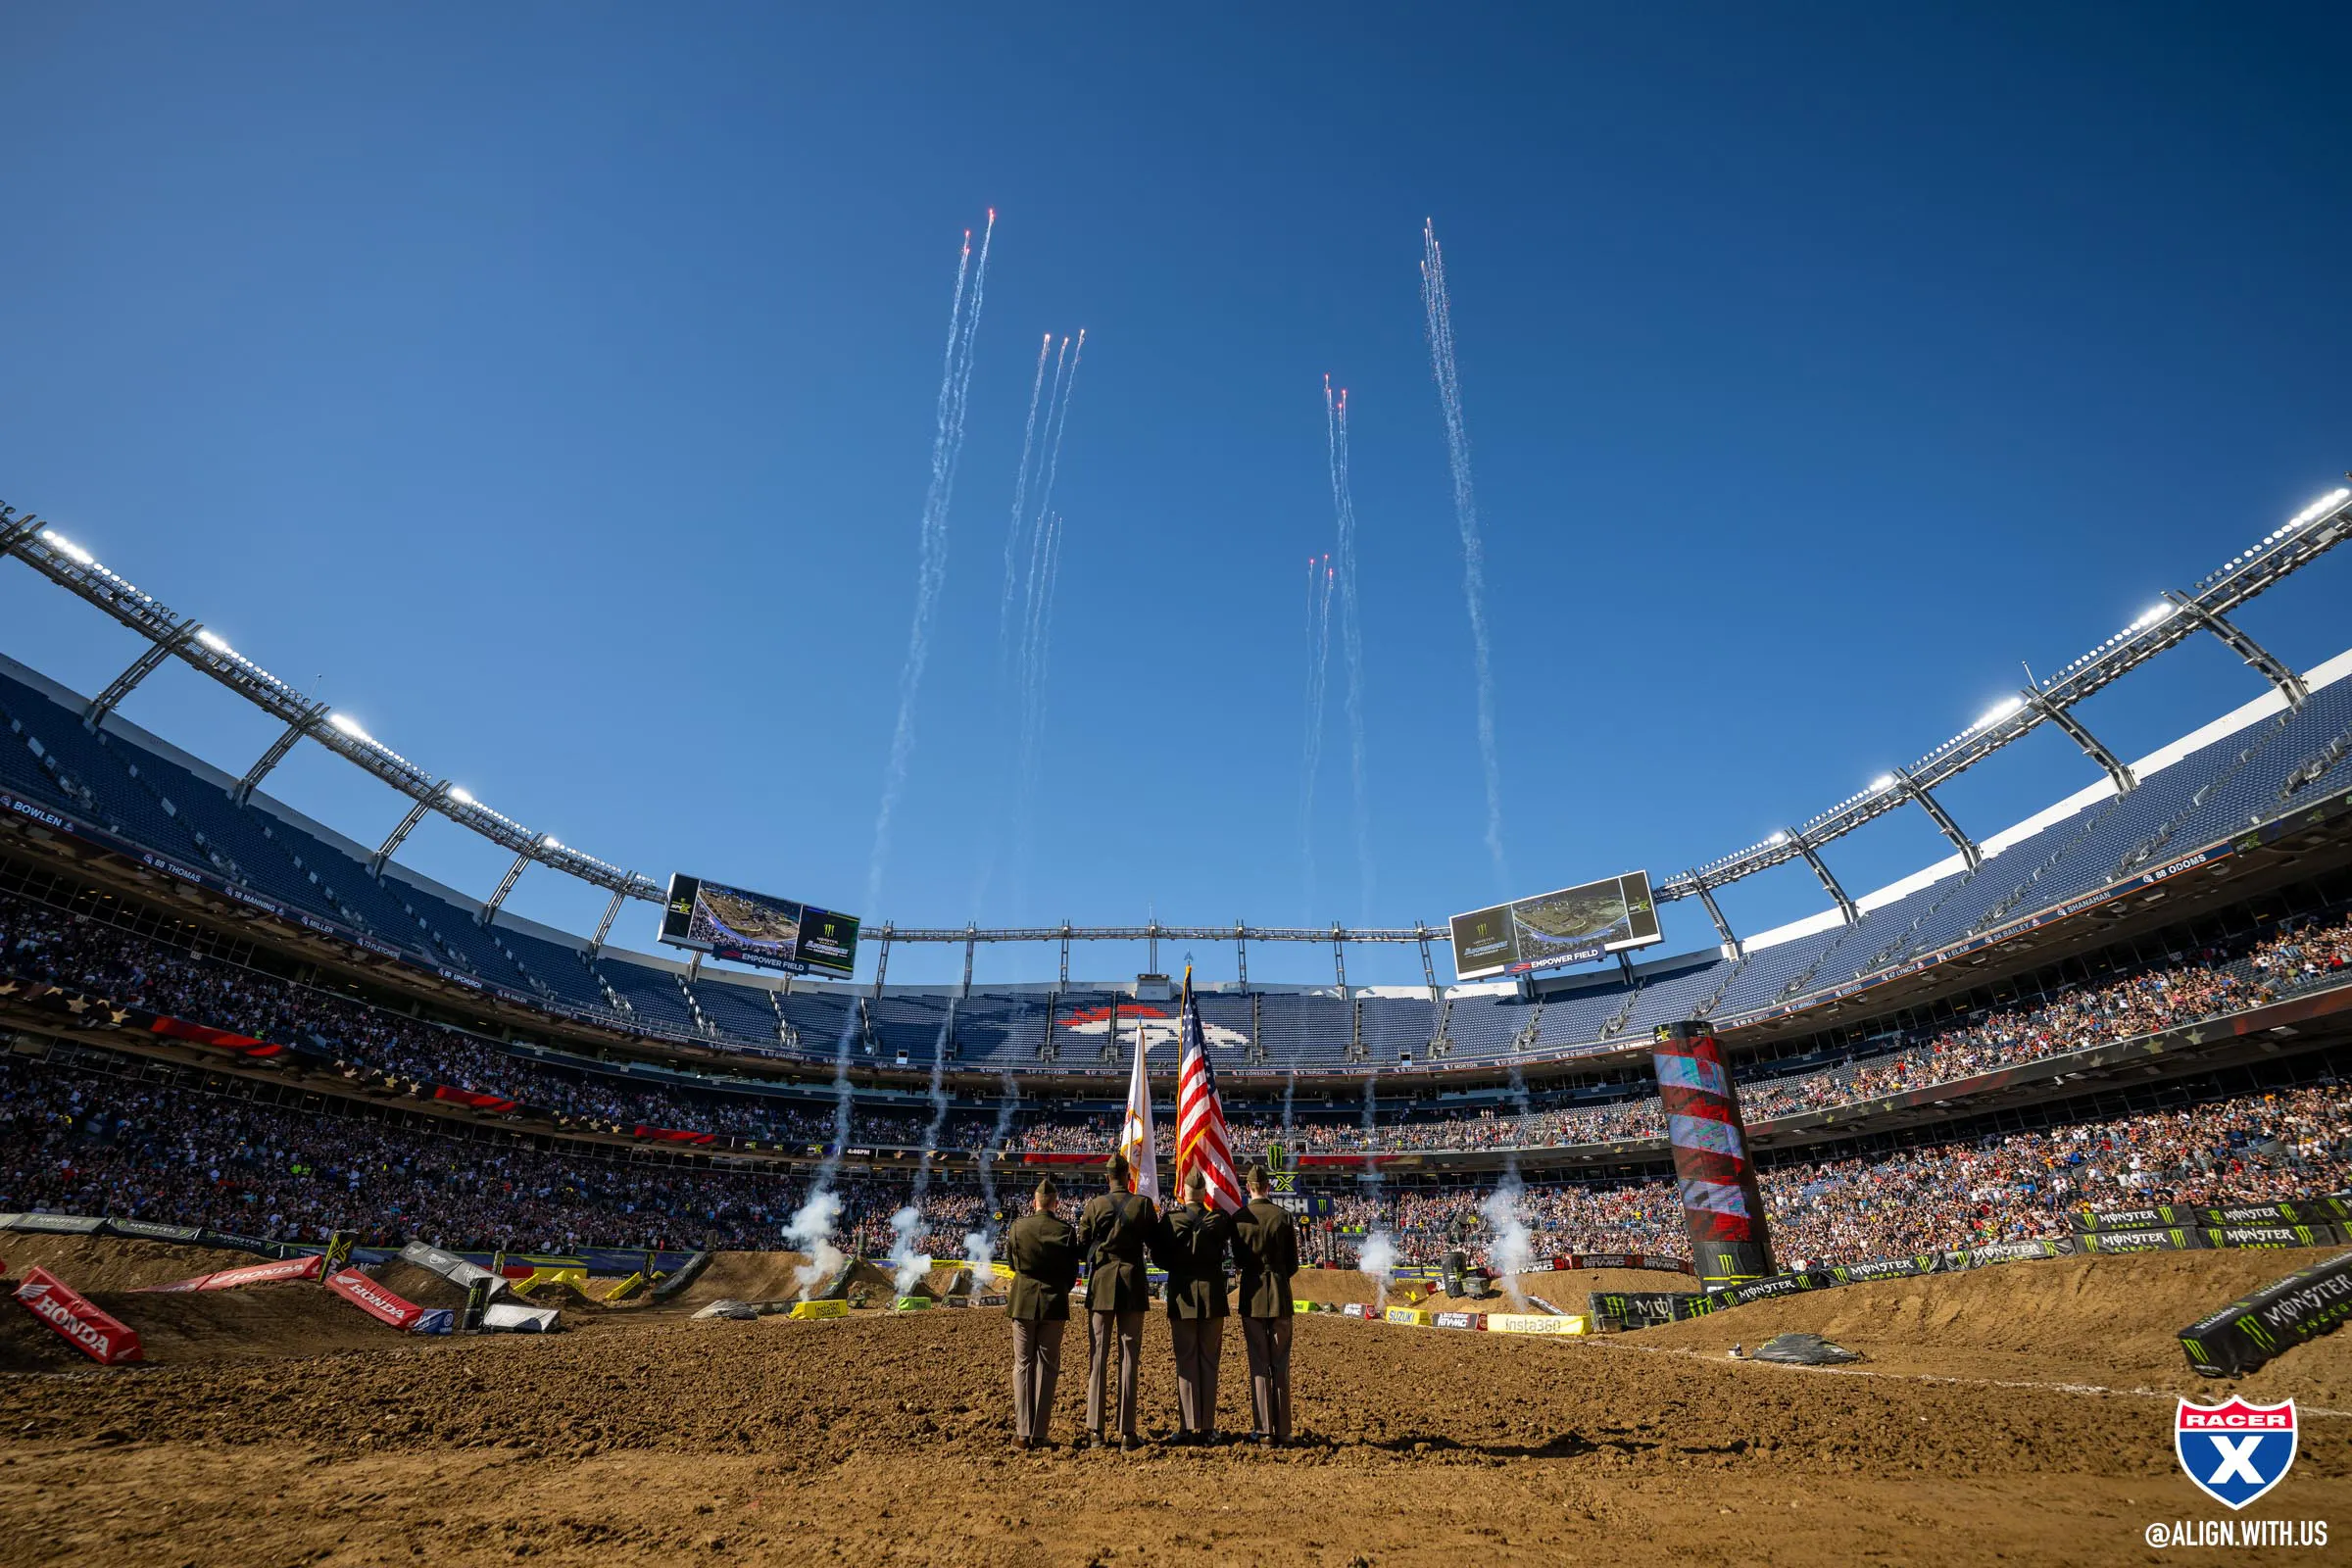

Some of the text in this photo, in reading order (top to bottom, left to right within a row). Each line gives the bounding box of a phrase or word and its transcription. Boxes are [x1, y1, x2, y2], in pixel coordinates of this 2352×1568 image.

[13, 801, 63, 827] BOWLEN
[169, 863, 202, 883] THOMAS
[2155, 854, 2207, 879] 88 ODOMS
[234, 890, 275, 912] 18 MANNING
[2067, 891, 2111, 913] SHANAHAN
[309, 919, 334, 934] MILLER
[2002, 922, 2030, 938] BAILEY
[370, 943, 400, 960] FLETCHER
[1951, 944, 1971, 956] ELAM
[742, 953, 805, 971] EMPOWER FIELD
[1531, 949, 1598, 968] EMPOWER FIELD
[1896, 964, 1916, 977] LYNCH
[453, 974, 482, 989] UPCHURCH
[1841, 983, 1862, 996] REEVES
[1798, 999, 1817, 1009] MINGO
[2099, 1209, 2157, 1223] MONSTER
[2224, 1206, 2279, 1221] MONSTER
[2101, 1232, 2168, 1247] MONSTER
[2226, 1227, 2295, 1243] MONSTER
[1971, 1243, 2040, 1258] MONSTER
[228, 1263, 305, 1282] HONDA
[1850, 1259, 1913, 1275] MONSTER
[1738, 1279, 1795, 1298] MONSTER
[348, 1284, 406, 1319] HONDA
[2262, 1273, 2352, 1327] MONSTER
[1388, 1310, 1415, 1323] SUZUKI
[35, 1294, 109, 1357] HONDA
